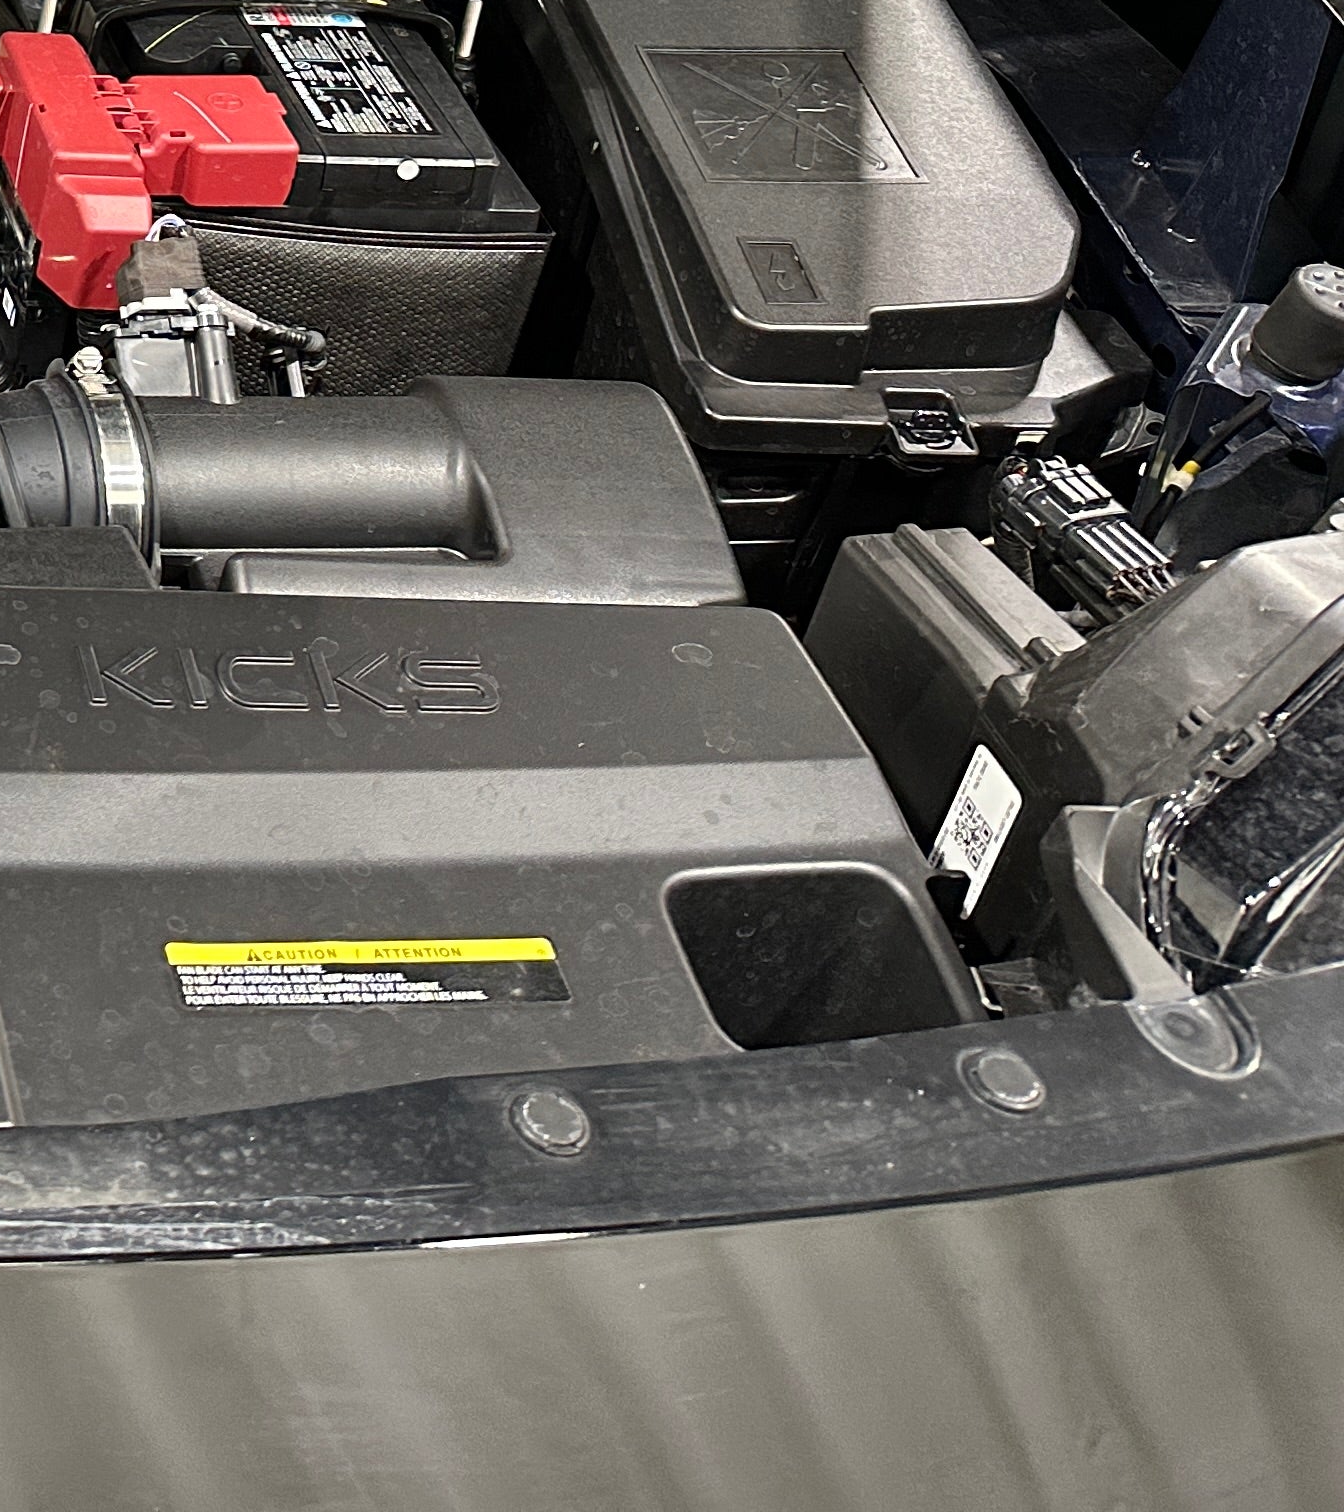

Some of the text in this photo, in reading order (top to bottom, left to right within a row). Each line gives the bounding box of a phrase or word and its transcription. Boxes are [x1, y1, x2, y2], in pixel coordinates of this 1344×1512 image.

[75, 644, 501, 715] KICKS
[262, 949, 337, 961] CAUTION
[374, 947, 462, 959] ATTENTION
